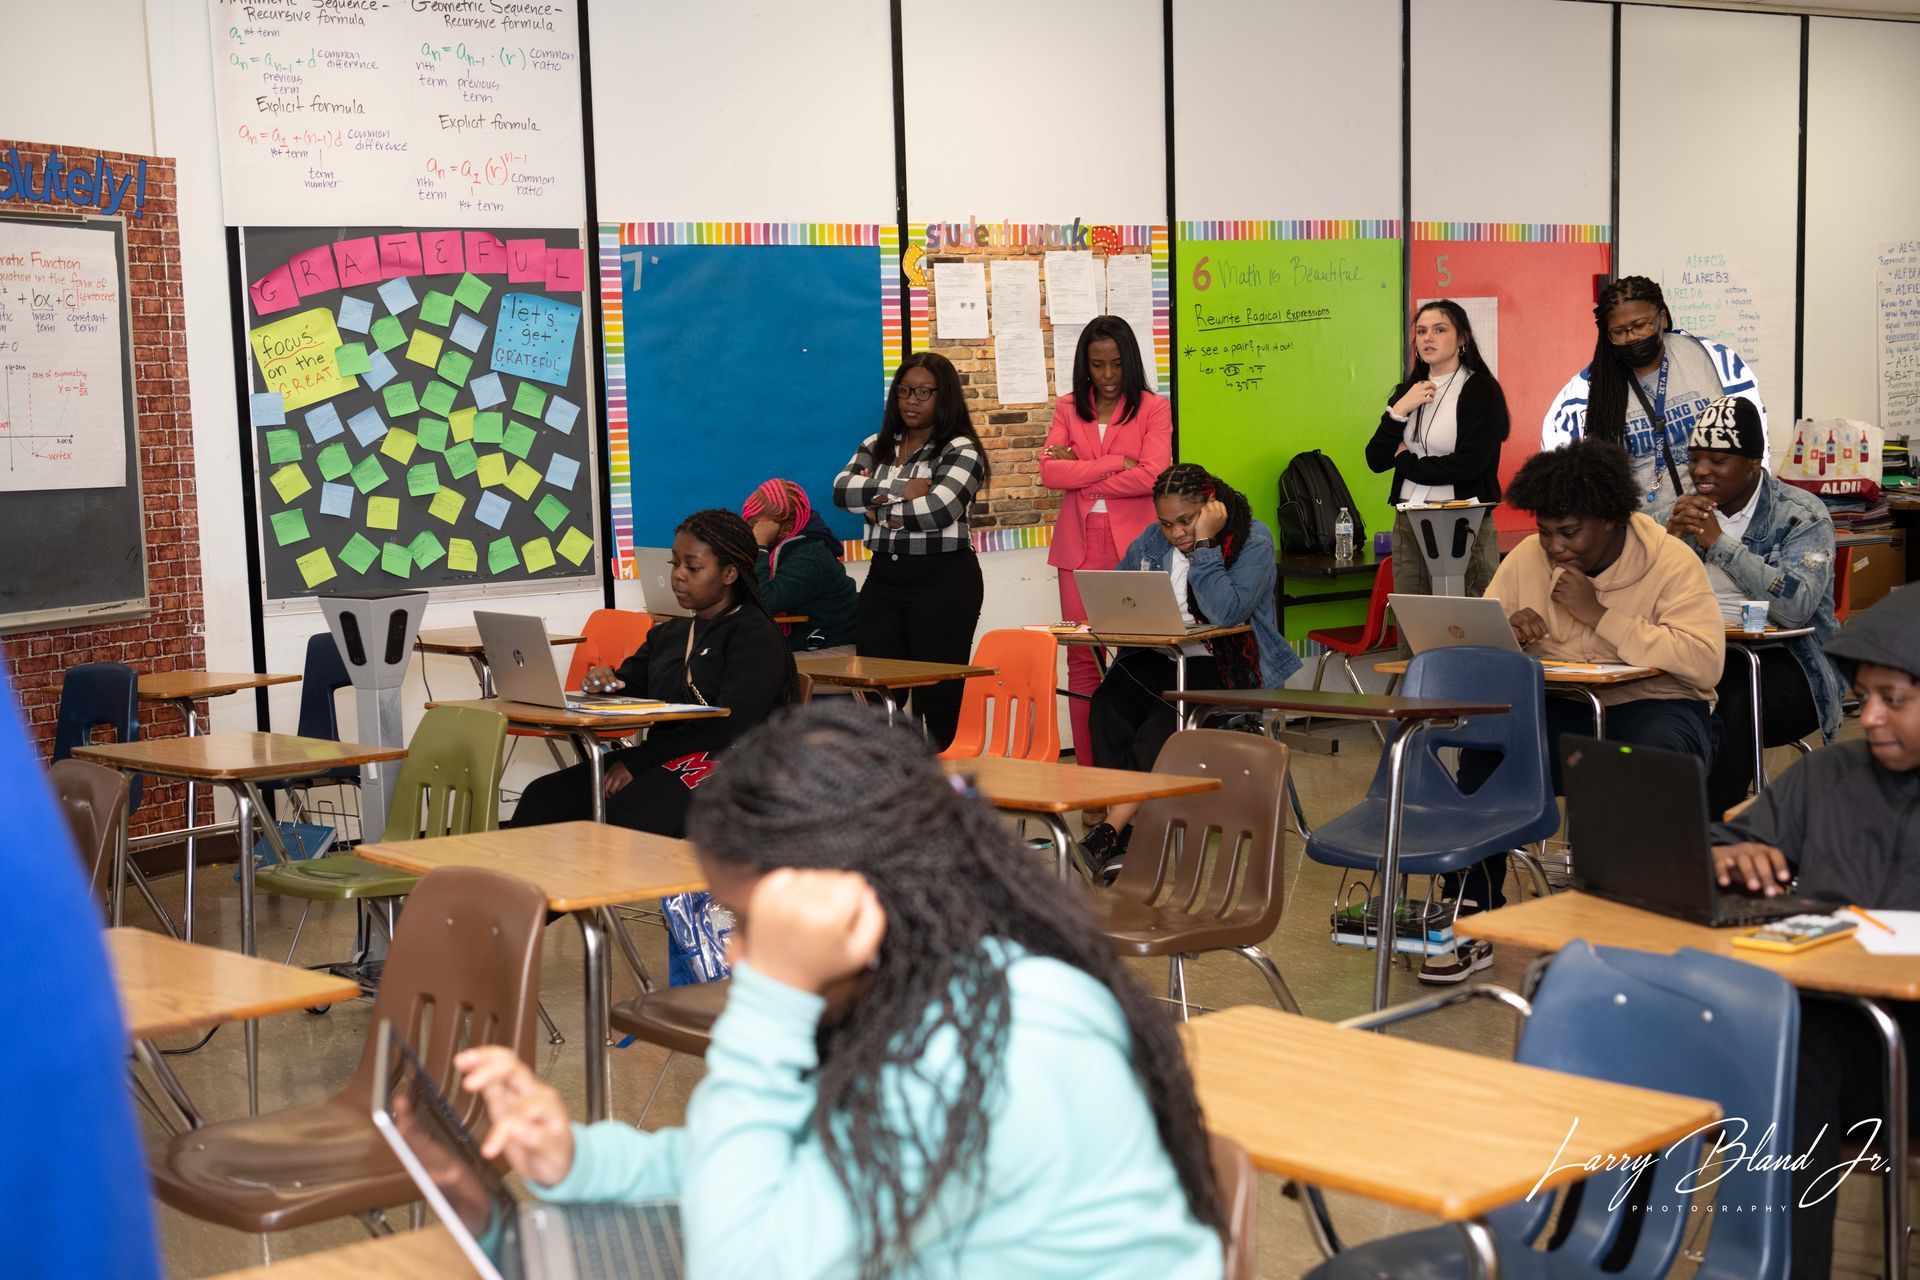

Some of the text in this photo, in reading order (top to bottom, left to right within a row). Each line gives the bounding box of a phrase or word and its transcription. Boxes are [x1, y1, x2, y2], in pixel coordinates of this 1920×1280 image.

[243, 7, 366, 26] Recursive formula
[444, 14, 556, 32] Recursive formula
[257, 27, 280, 37] term
[318, 50, 360, 59] common
[529, 48, 575, 61] common
[327, 57, 379, 69] difference
[533, 60, 562, 71] ratio
[263, 72, 303, 83] previous
[419, 76, 448, 88] term
[272, 84, 300, 95] term
[457, 77, 500, 93] previous
[462, 91, 493, 104] term
[256, 95, 365, 116] Explicit formula
[438, 113, 541, 134] Explicit formula
[348, 129, 390, 140] common
[355, 139, 408, 151] difference
[285, 149, 308, 159] term
[308, 167, 334, 179] term
[511, 172, 555, 184] common
[304, 179, 342, 189] number
[517, 184, 543, 196] ratio
[418, 189, 447, 201] term
[476, 200, 504, 213] term
[926, 215, 1089, 251] student work
[31, 251, 81, 270] Function
[1193, 256, 1212, 292] 6
[1218, 259, 1262, 289] Math
[1290, 255, 1364, 287] Beautiful
[1435, 255, 1453, 287] 5
[49, 272, 66, 286] the
[71, 272, 93, 289] form
[97, 277, 108, 291] of
[32, 312, 58, 321] linear
[67, 311, 108, 322] constant
[510, 296, 555, 328] let's
[1194, 303, 1331, 328] Rewrite Radical Expressions
[36, 322, 56, 333] term
[74, 322, 98, 333] term
[521, 328, 552, 346] get
[262, 331, 315, 360] focus
[1201, 346, 1219, 357] see
[1231, 340, 1255, 359] pair?
[1256, 343, 1270, 358] pull
[495, 348, 561, 372] GRATEFUL
[268, 354, 326, 380] on the
[278, 366, 334, 400] GREAT
[1658, 377, 1667, 395] ZETA
[1699, 406, 1737, 429] DIS
[1689, 427, 1742, 449] NEY
[48, 451, 72, 461] vertex
